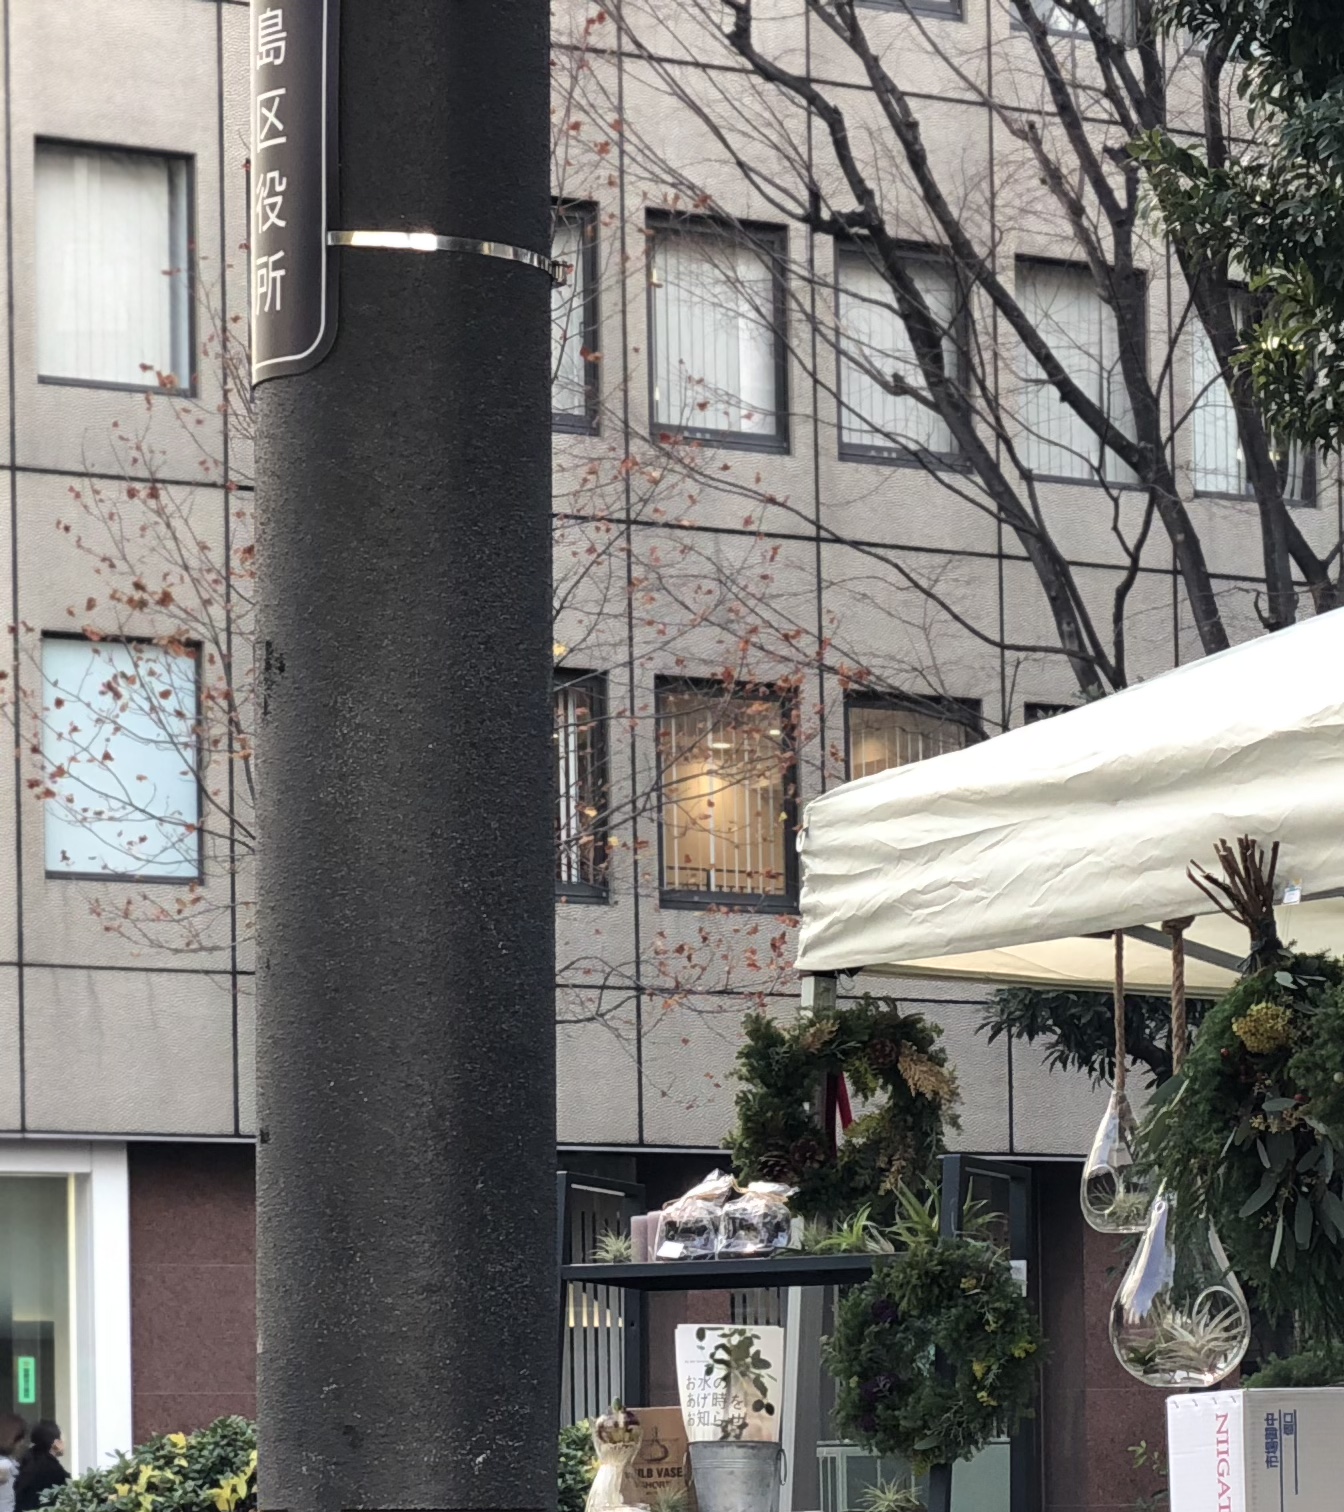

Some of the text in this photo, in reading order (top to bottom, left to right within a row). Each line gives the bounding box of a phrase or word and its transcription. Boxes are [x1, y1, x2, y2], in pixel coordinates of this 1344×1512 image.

[255, 8, 287, 315] 島区役所
[686, 1375, 728, 1391] お水の
[686, 1392, 744, 1410] あげ時を
[656, 1466, 683, 1478] VASE
